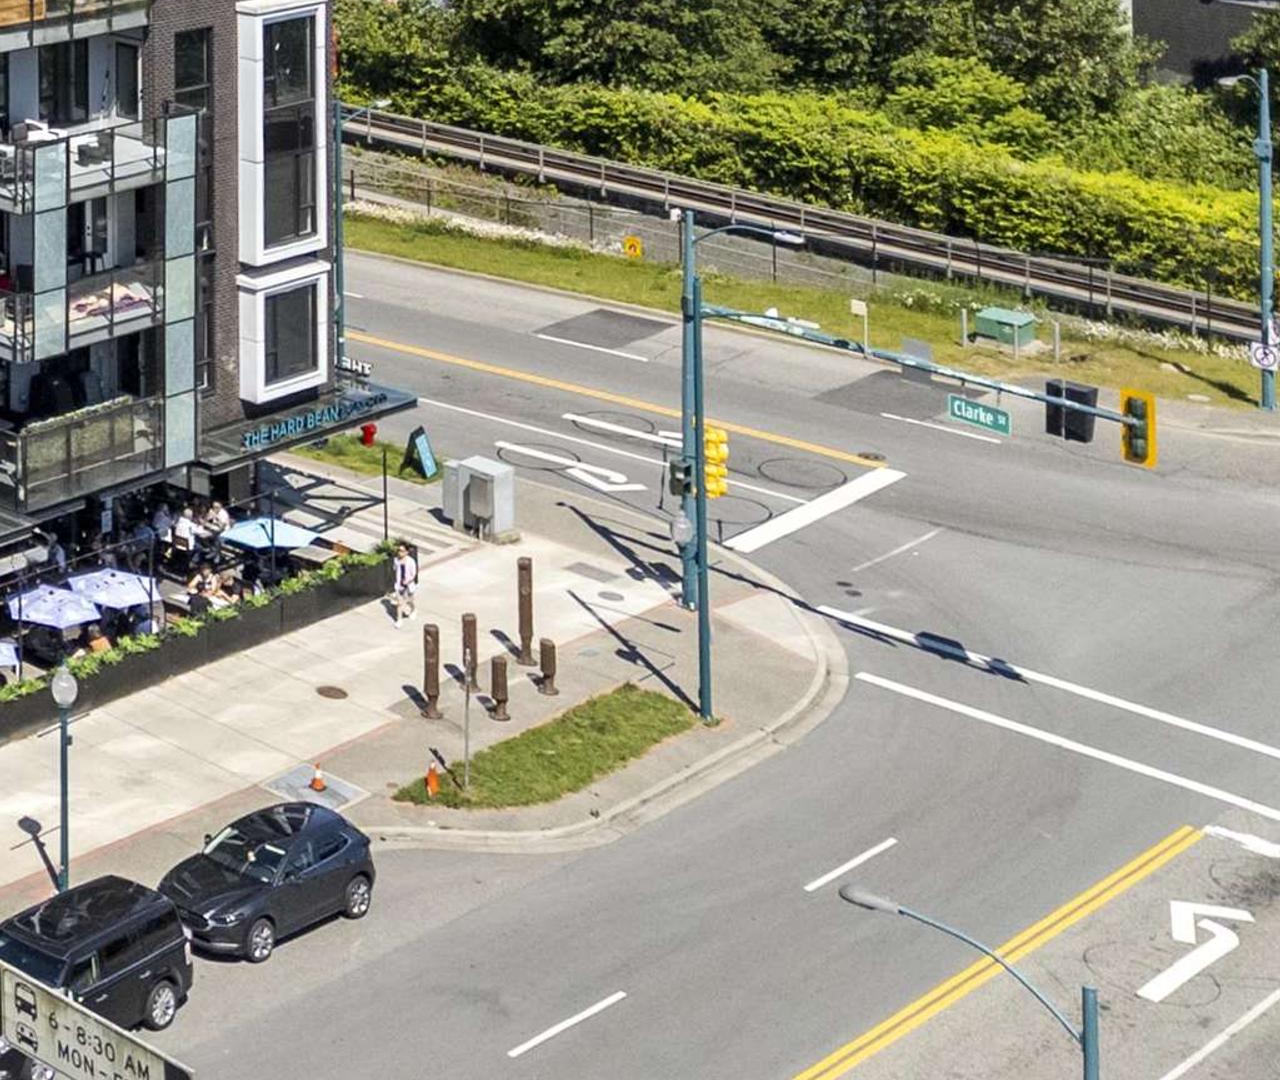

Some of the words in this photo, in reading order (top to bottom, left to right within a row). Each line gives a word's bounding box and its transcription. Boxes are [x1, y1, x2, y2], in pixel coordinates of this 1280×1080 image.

[244, 428, 269, 449] THE
[271, 417, 304, 441] HARD
[307, 406, 339, 429] BEAN
[953, 400, 994, 425] Clarke
[48, 1011, 58, 1030] 6
[76, 1026, 115, 1062] 8:30
[124, 1054, 150, 1080] AM
[57, 1040, 95, 1077] MON
